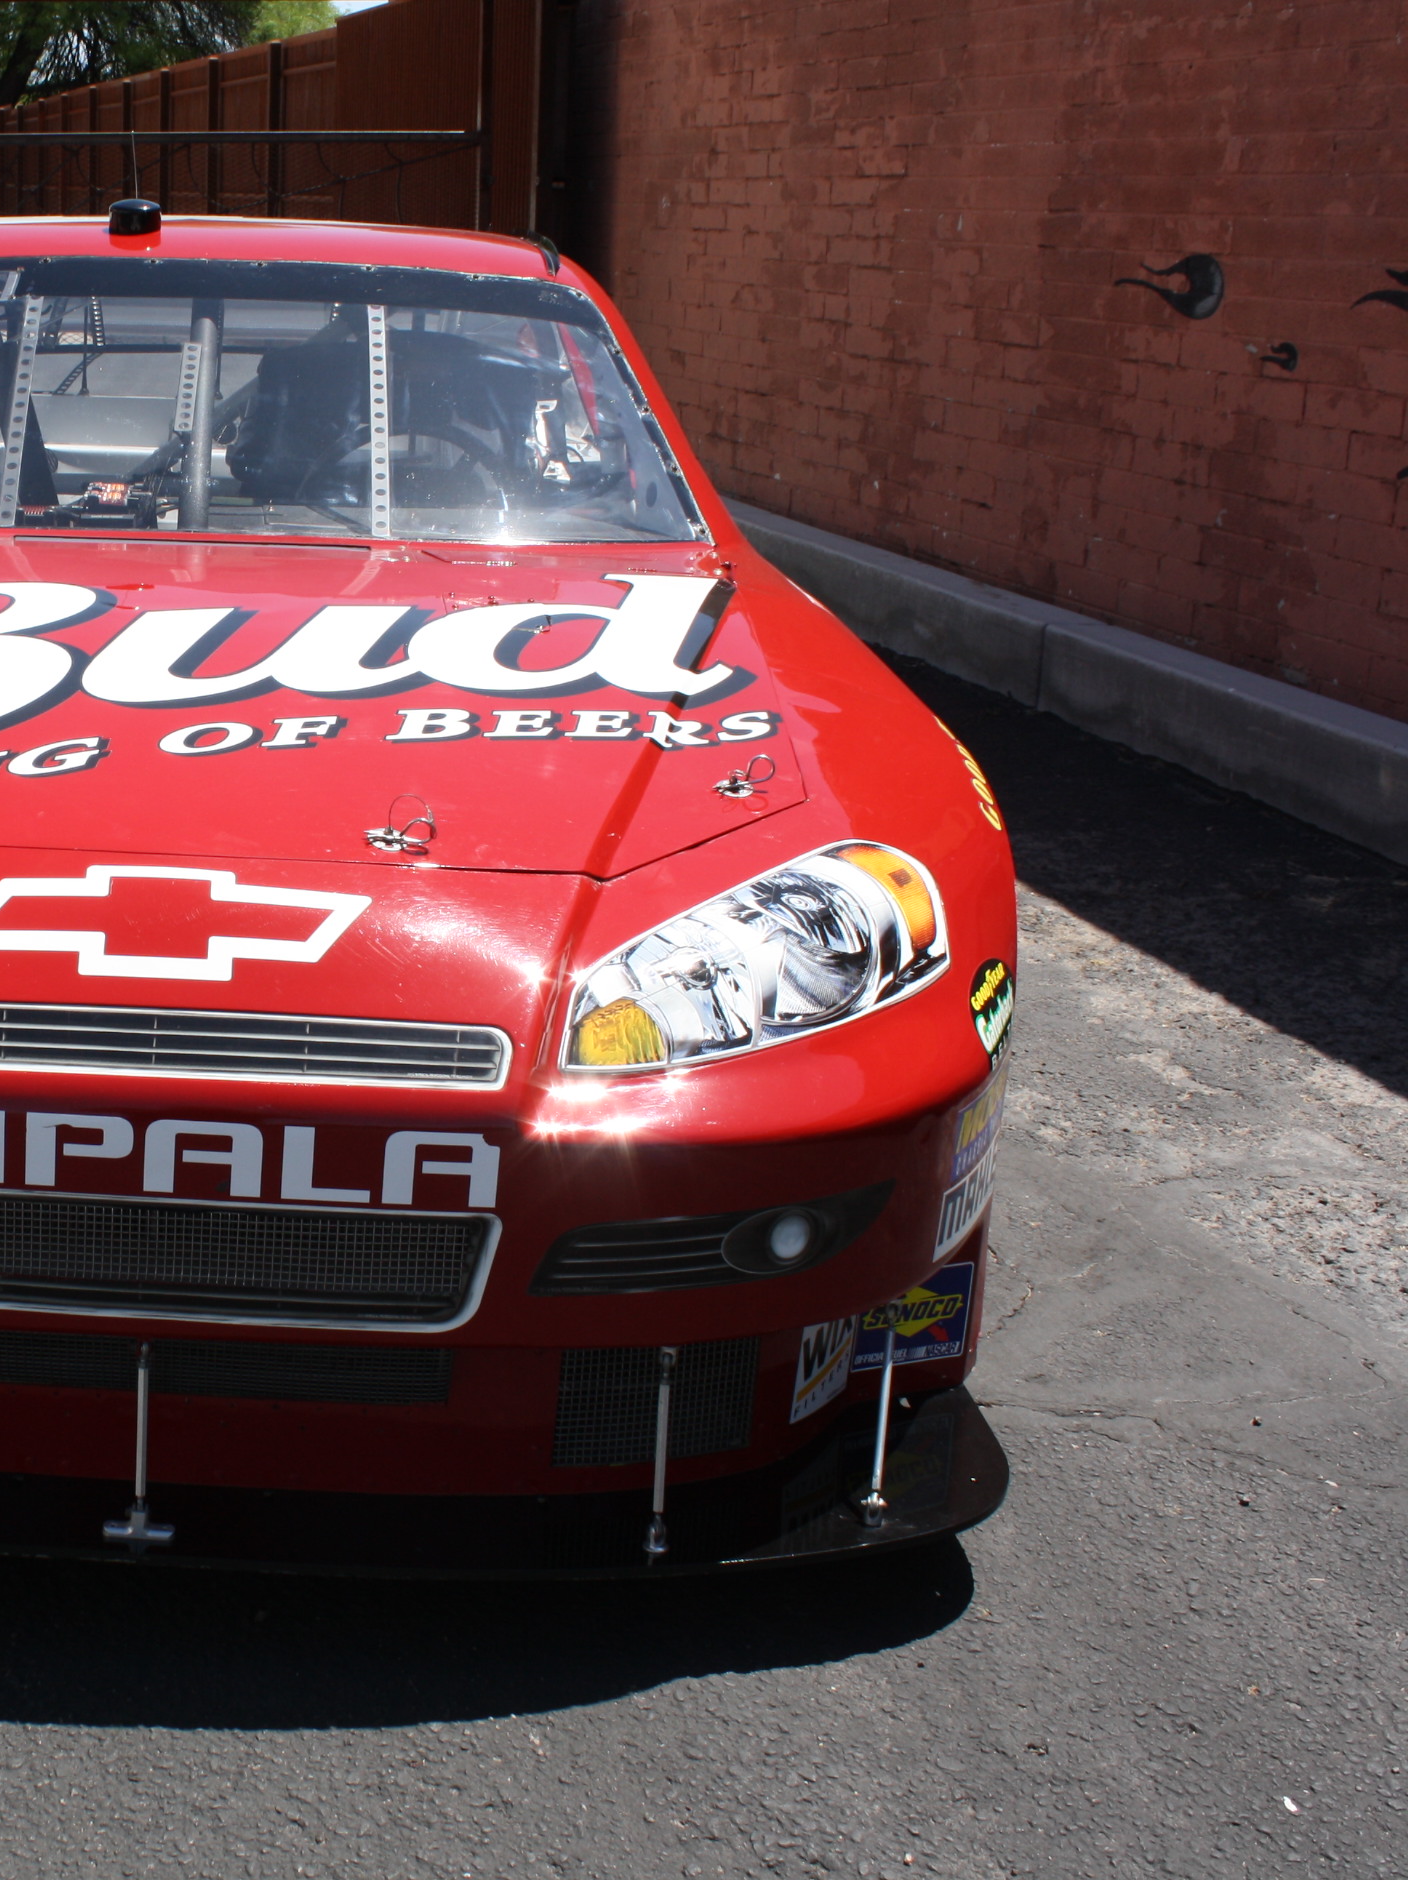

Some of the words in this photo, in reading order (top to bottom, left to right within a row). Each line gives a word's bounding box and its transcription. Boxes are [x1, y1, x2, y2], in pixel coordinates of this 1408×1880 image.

[158, 712, 347, 756] OF
[385, 708, 783, 751] BEERS
[970, 962, 1005, 1011] GOODYEAR
[854, 1352, 885, 1366] OFFICIA
